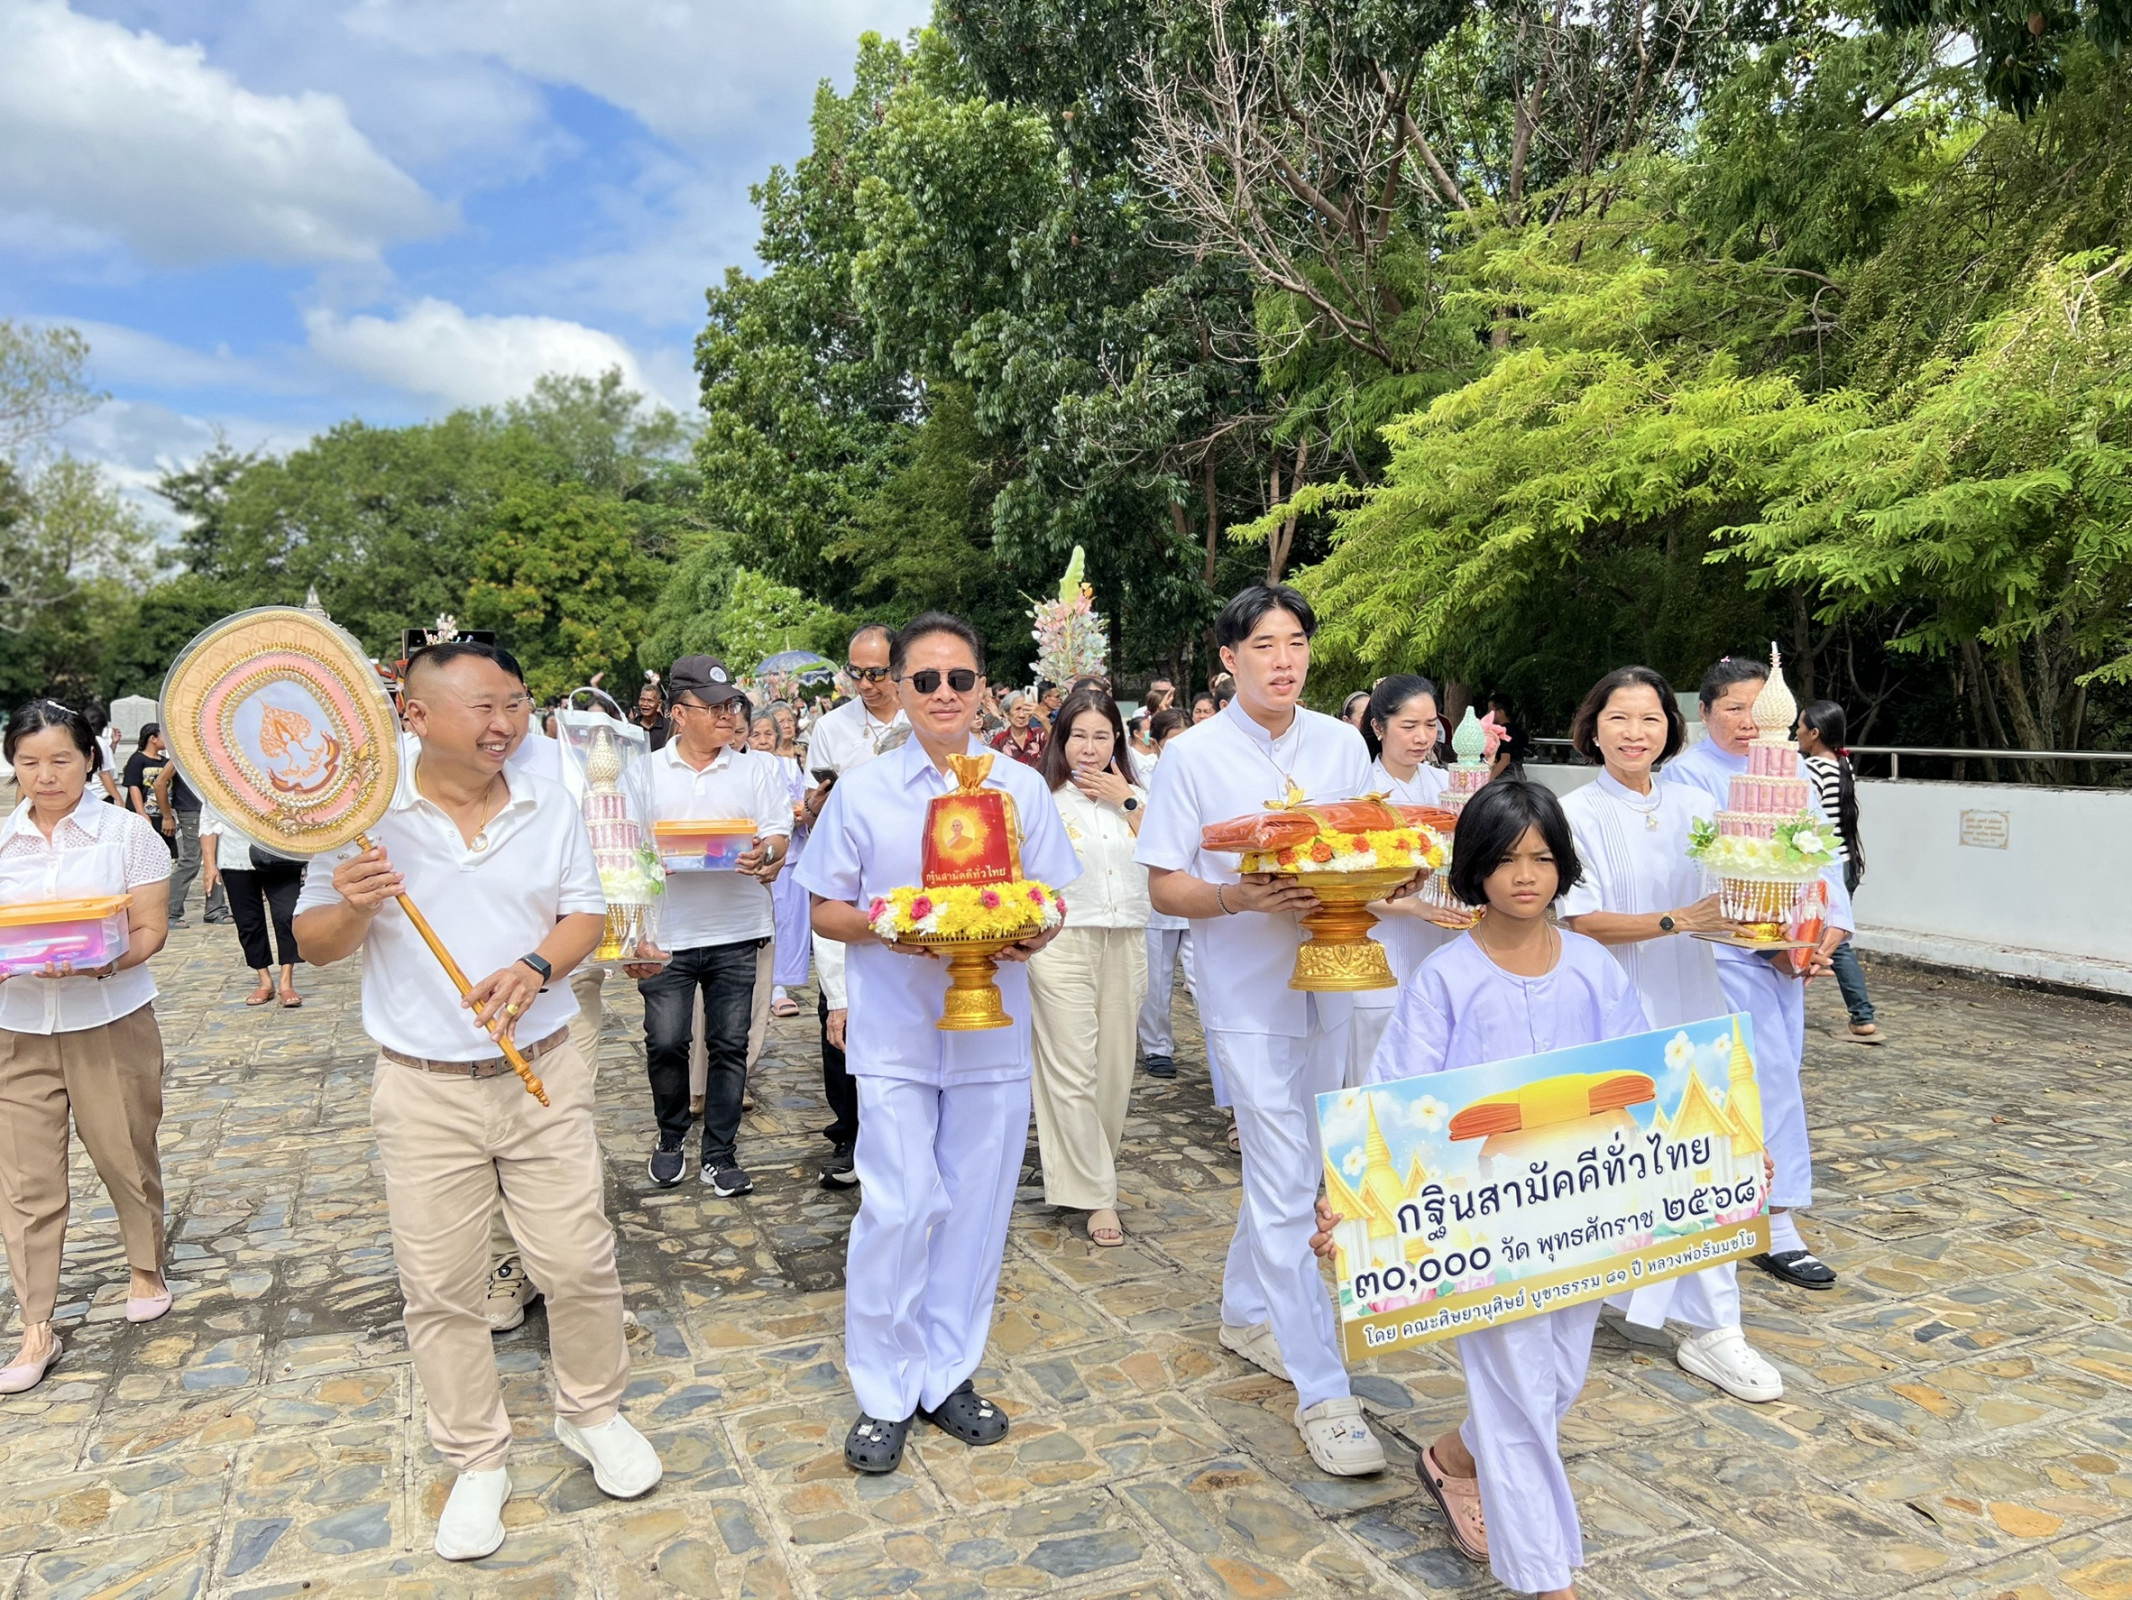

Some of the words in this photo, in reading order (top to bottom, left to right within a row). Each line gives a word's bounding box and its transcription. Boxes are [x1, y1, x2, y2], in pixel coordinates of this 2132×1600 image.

[1355, 1246, 1491, 1299] ๓๐,๐๐๐
[1501, 1236, 1530, 1263] วัด
[1537, 1209, 1654, 1263] พุทธศักราช
[1662, 1175, 1756, 1222] ๒๕๖๘
[1397, 1131, 1711, 1241] กฐินสามัคคีทั่วไทย
[1364, 1326, 1397, 1345] โดย
[1403, 1290, 1525, 1335] คณะศิษยานุศิษย์
[1530, 1274, 1601, 1308] บูชาธรรม
[1606, 1269, 1627, 1285] ๘๑
[1632, 1260, 1642, 1276] ปี
[1647, 1231, 1756, 1274] หลวงพ่อธัมมชโย
